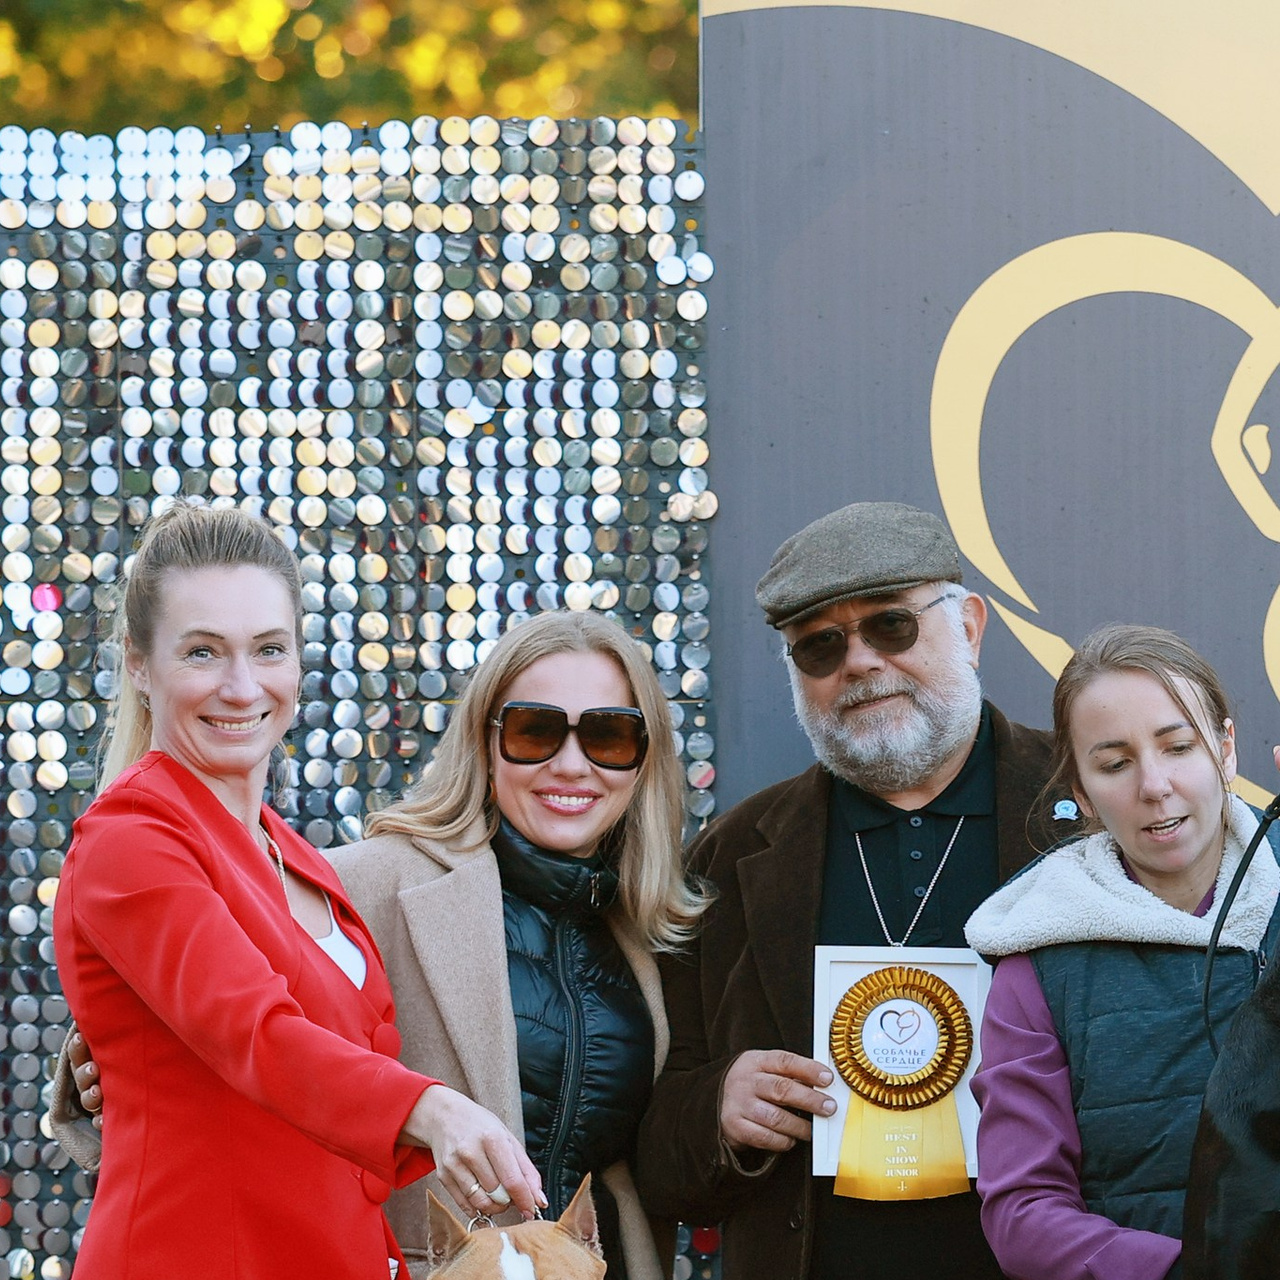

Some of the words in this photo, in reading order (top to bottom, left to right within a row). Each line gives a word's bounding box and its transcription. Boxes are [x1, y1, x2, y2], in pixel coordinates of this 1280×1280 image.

[873, 1048, 926, 1056] СОБАЧЬЕ
[876, 1056, 922, 1064] СЕРДЦЕ
[885, 1156, 918, 1164] SHOW
[885, 1168, 919, 1177] JUNIOR
